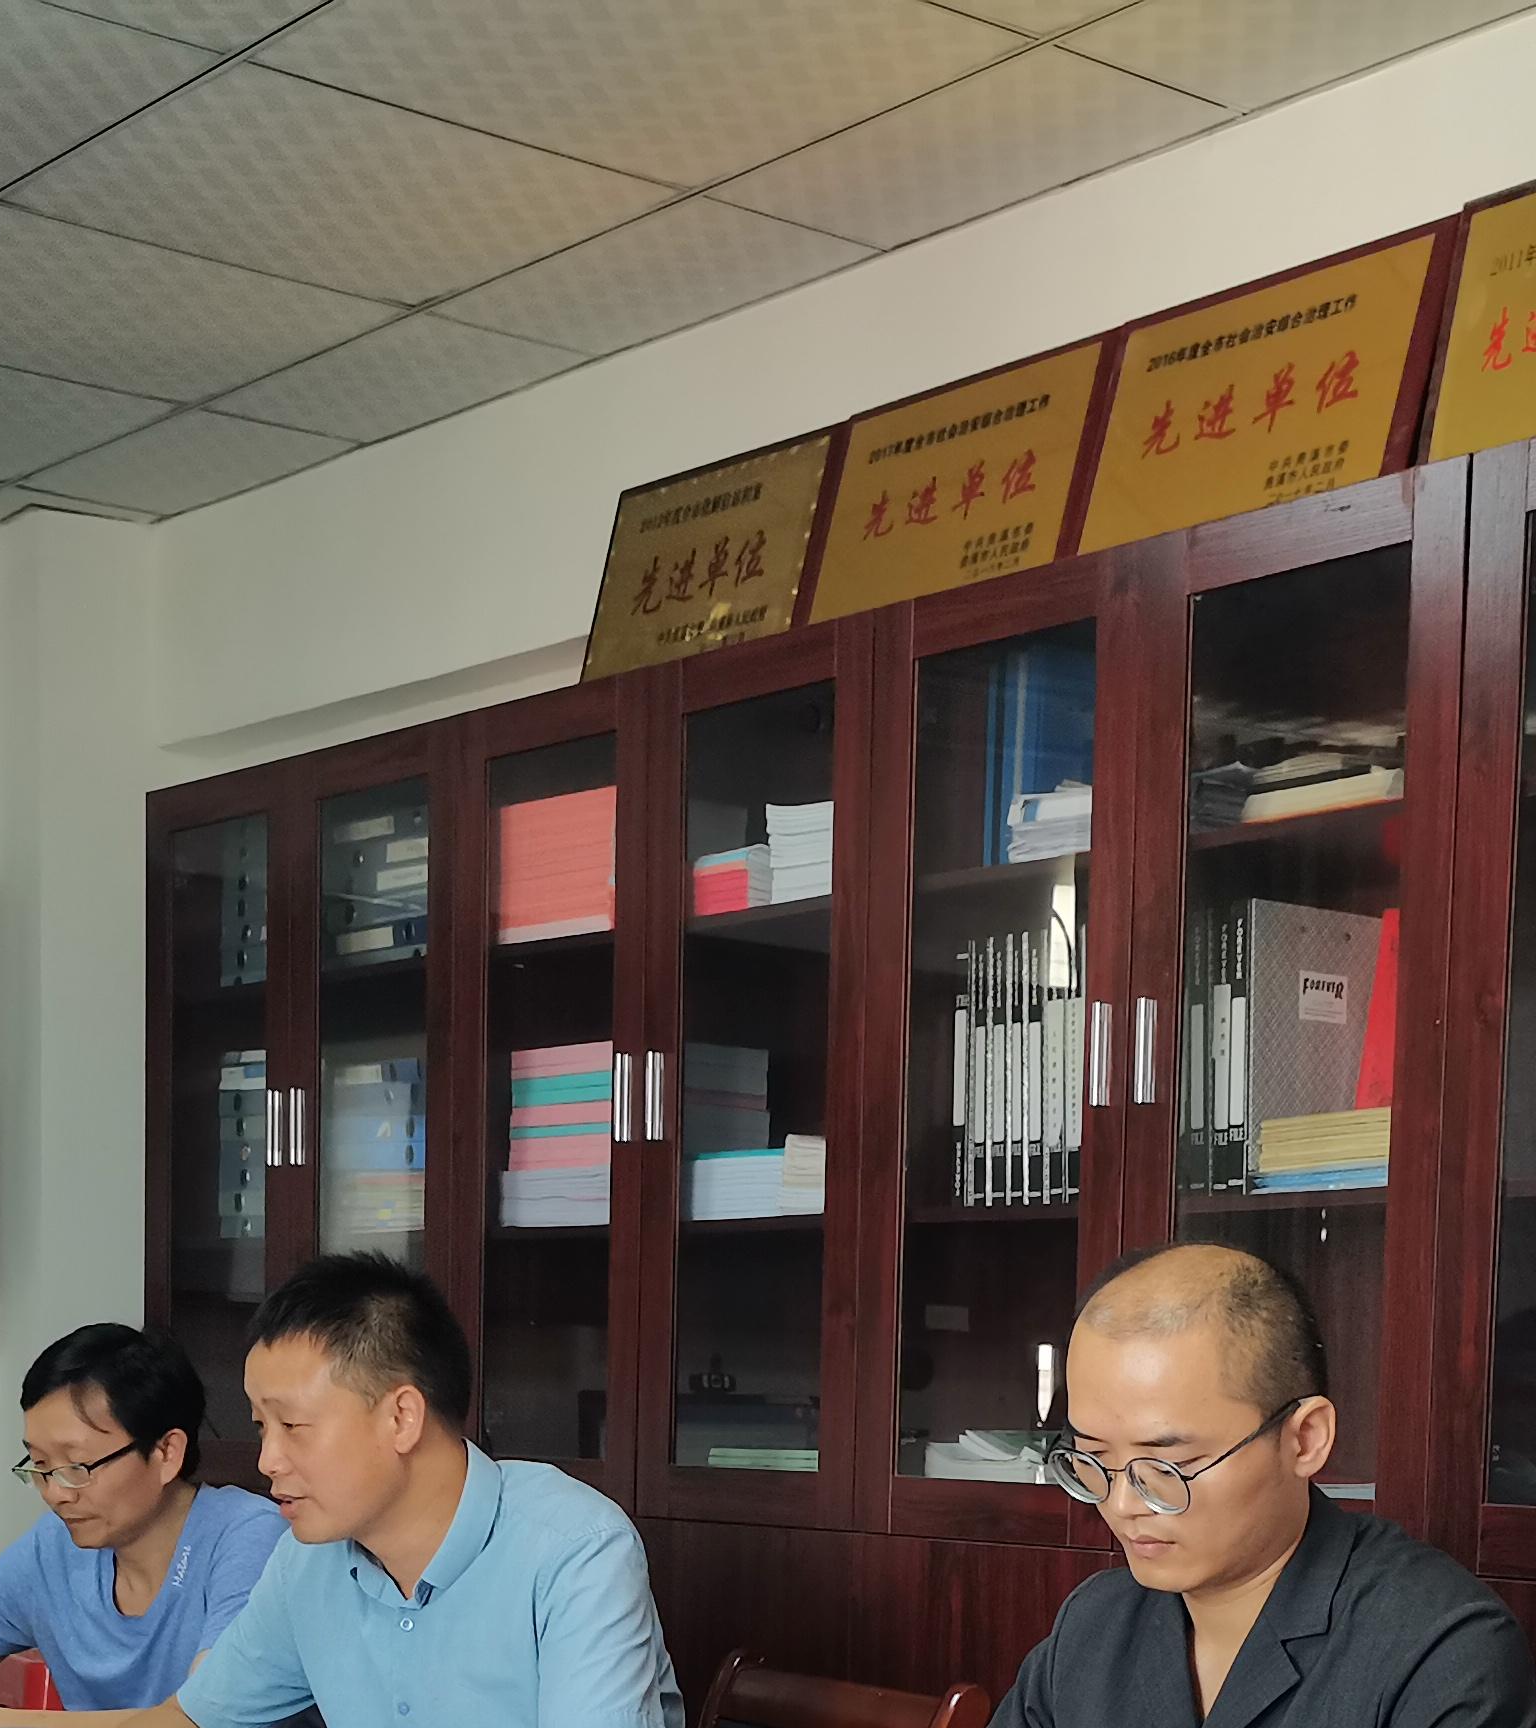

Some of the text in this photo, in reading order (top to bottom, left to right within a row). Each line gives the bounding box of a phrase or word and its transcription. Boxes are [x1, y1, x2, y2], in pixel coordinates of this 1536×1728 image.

[1142, 350, 1360, 459] 先进单位
[863, 448, 1037, 541] 先进单位
[630, 529, 768, 616] 先进单位
